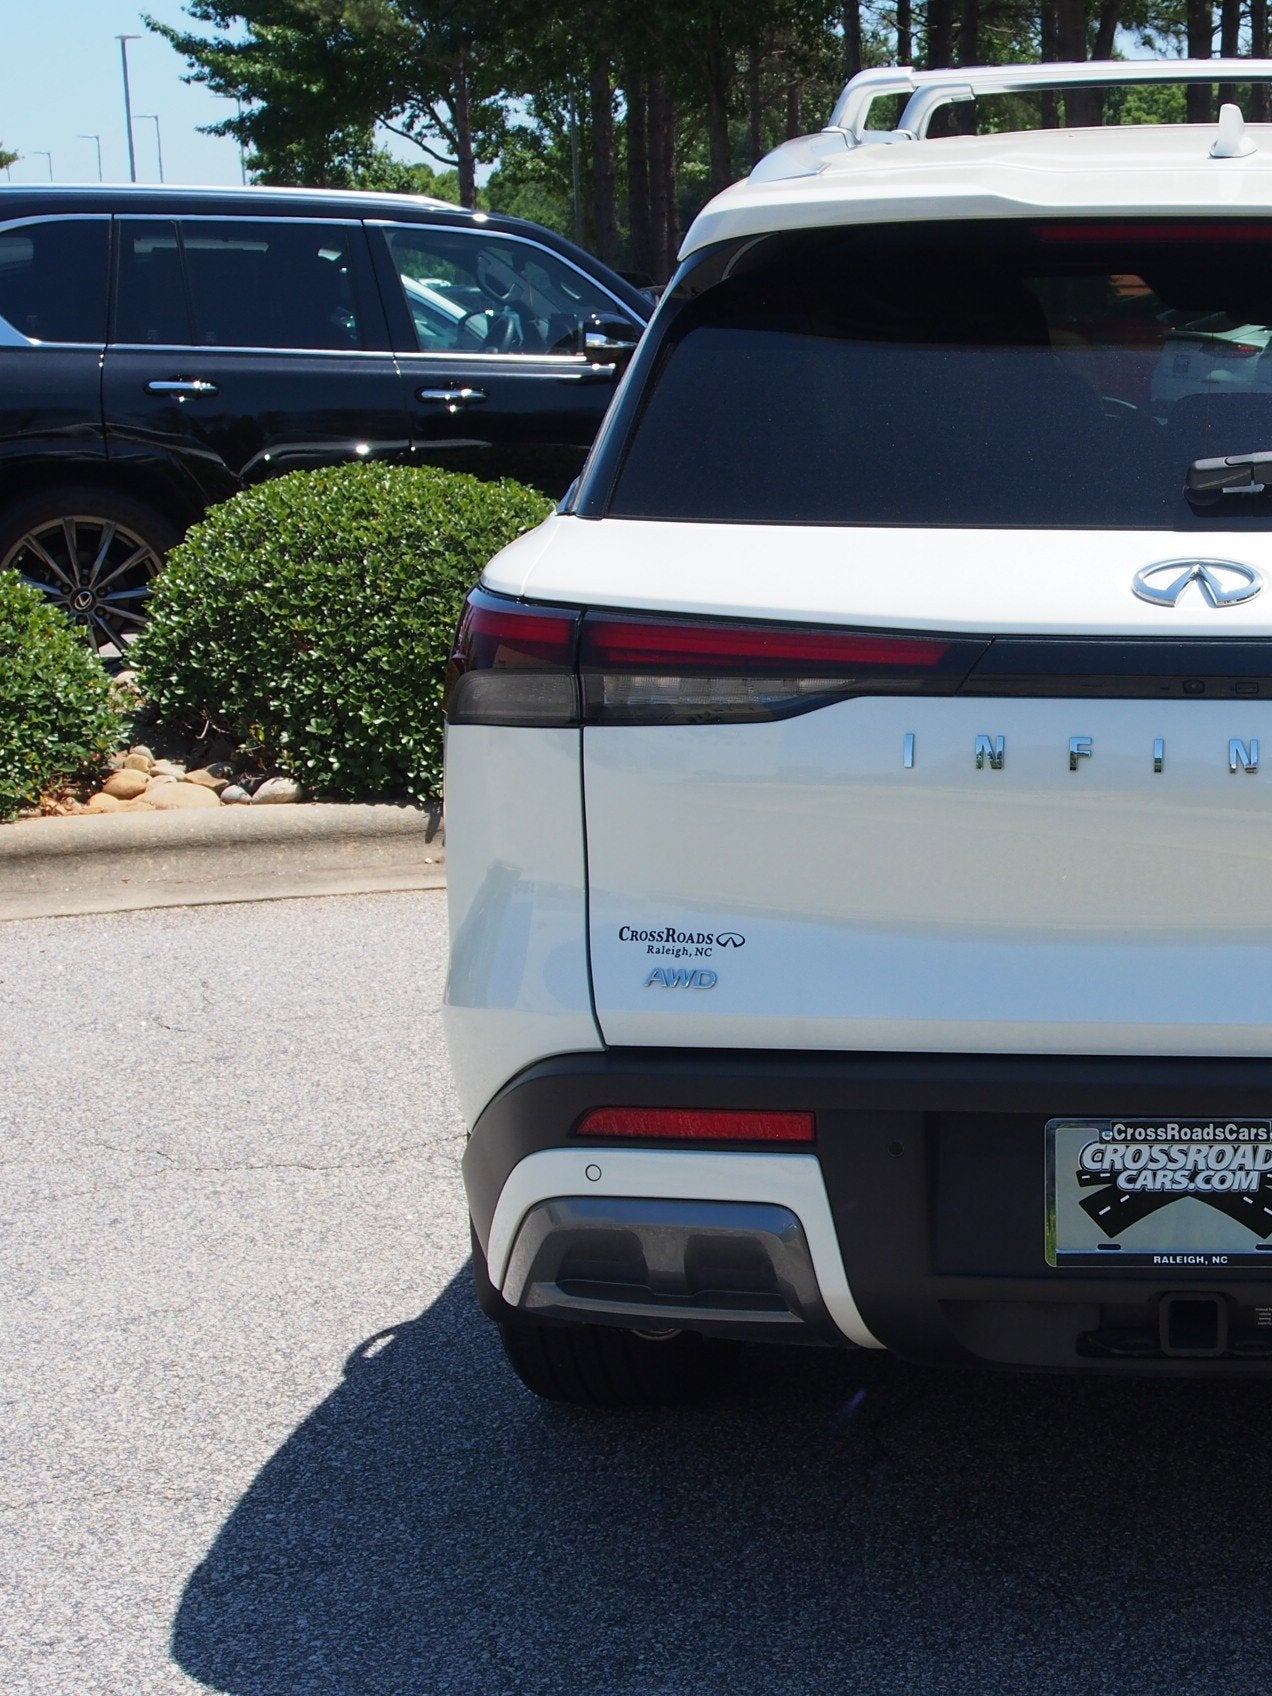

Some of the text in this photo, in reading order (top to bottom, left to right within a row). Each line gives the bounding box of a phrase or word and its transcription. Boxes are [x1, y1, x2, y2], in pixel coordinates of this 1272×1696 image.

[646, 945, 713, 958] Raleigh, NC
[643, 966, 718, 990] AWD
[1112, 1123, 1268, 1141] CrossRoadsCars
[1116, 1170, 1262, 1192] CARS.COM
[1153, 1255, 1228, 1265] RALEIGH, NC
